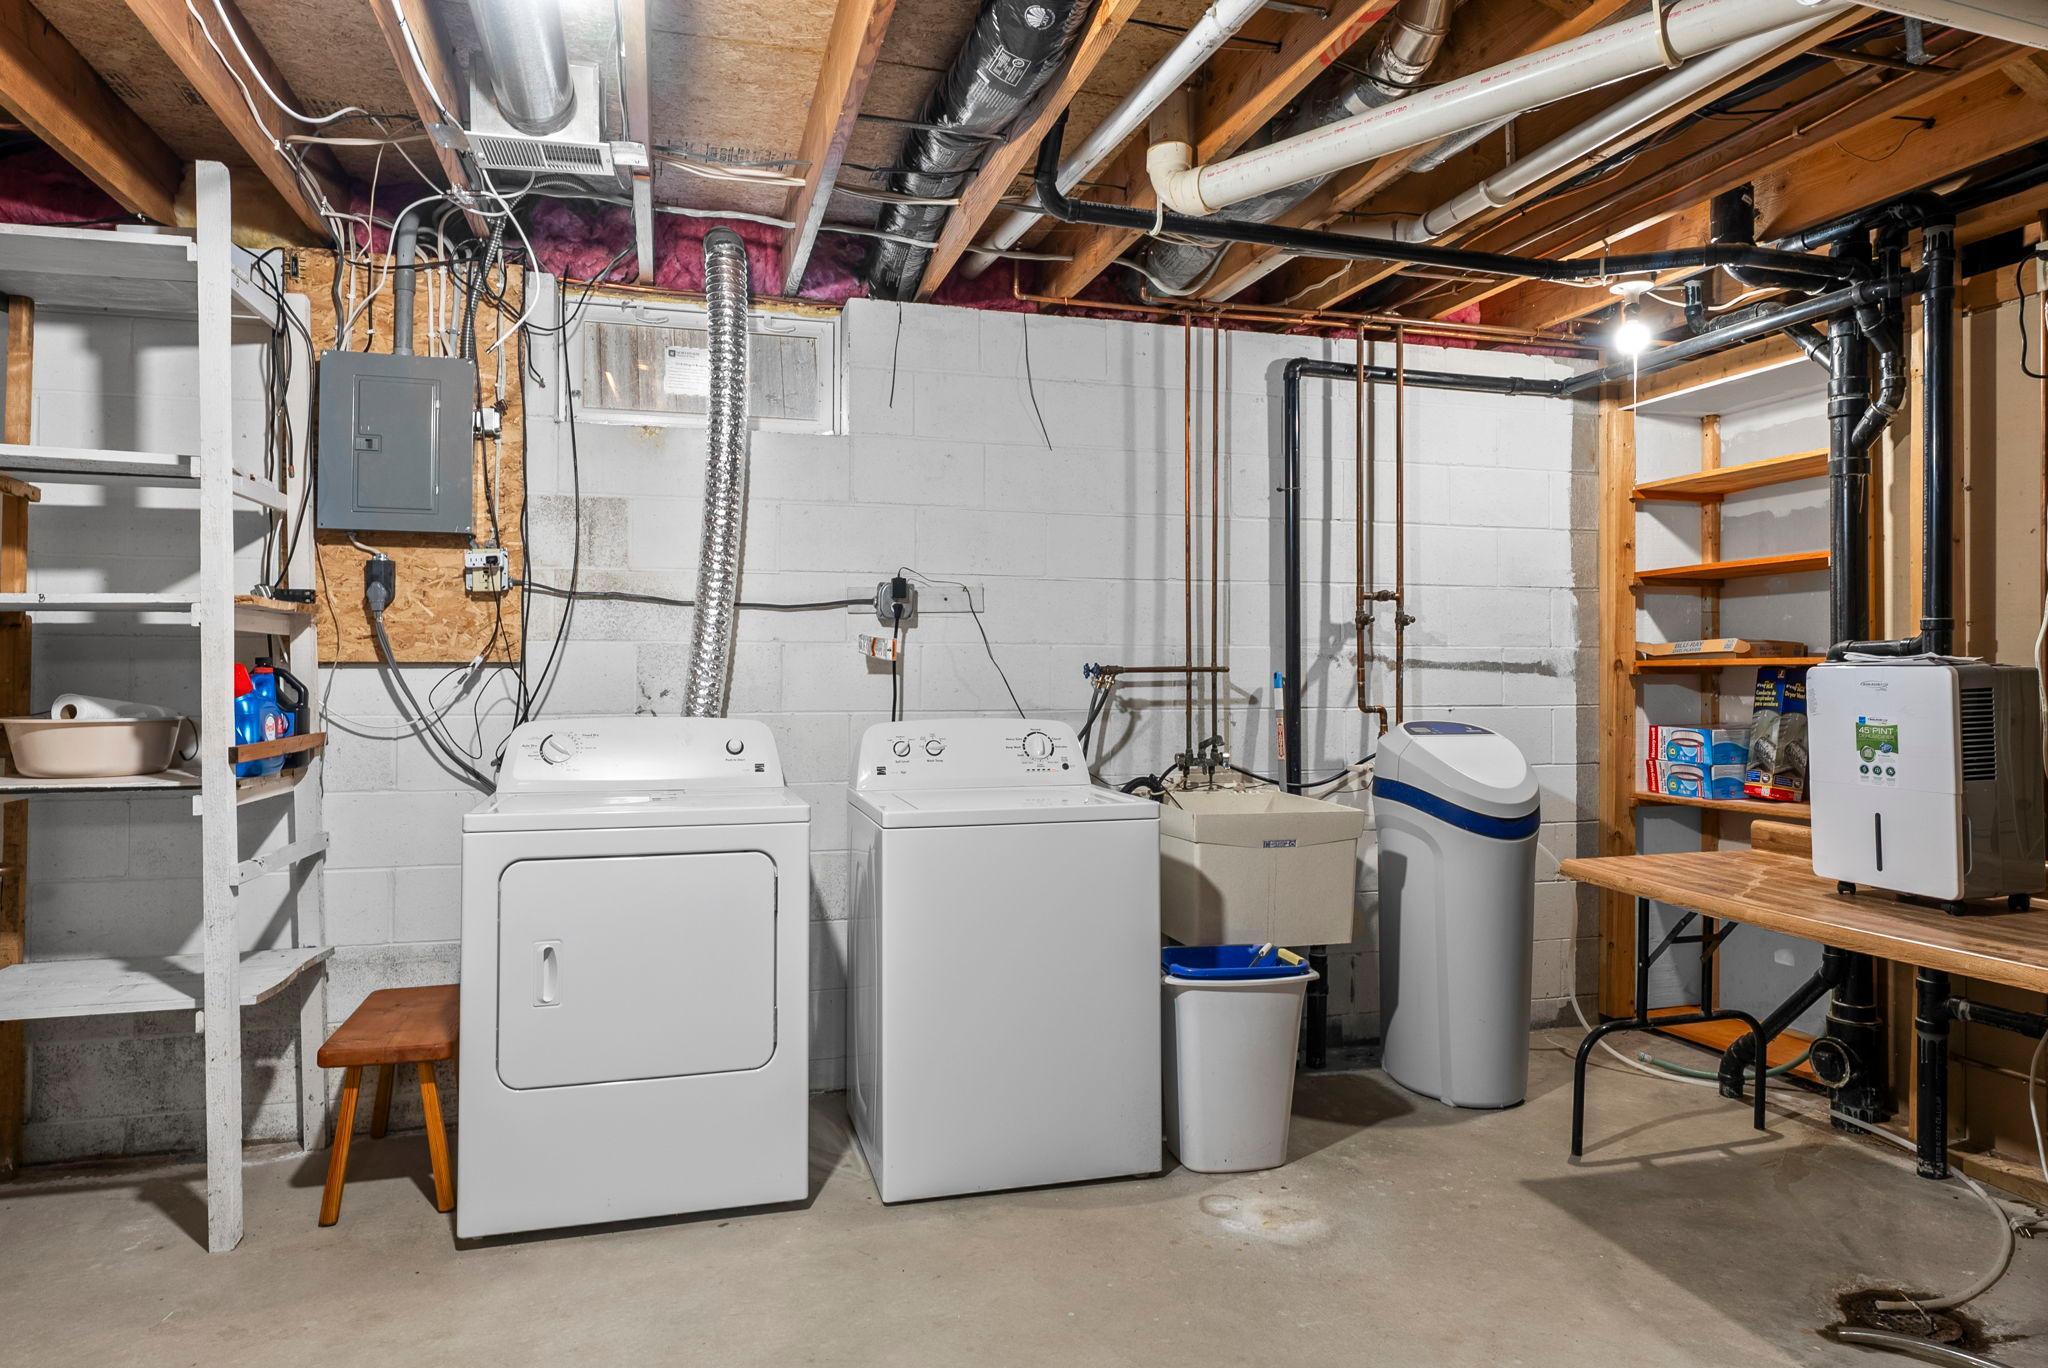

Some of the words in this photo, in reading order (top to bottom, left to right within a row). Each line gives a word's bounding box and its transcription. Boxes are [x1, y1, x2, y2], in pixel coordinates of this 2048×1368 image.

[1674, 641, 1703, 649] BLU-RAY
[1858, 726, 1870, 734] 45
[1872, 727, 1894, 735] PINT
